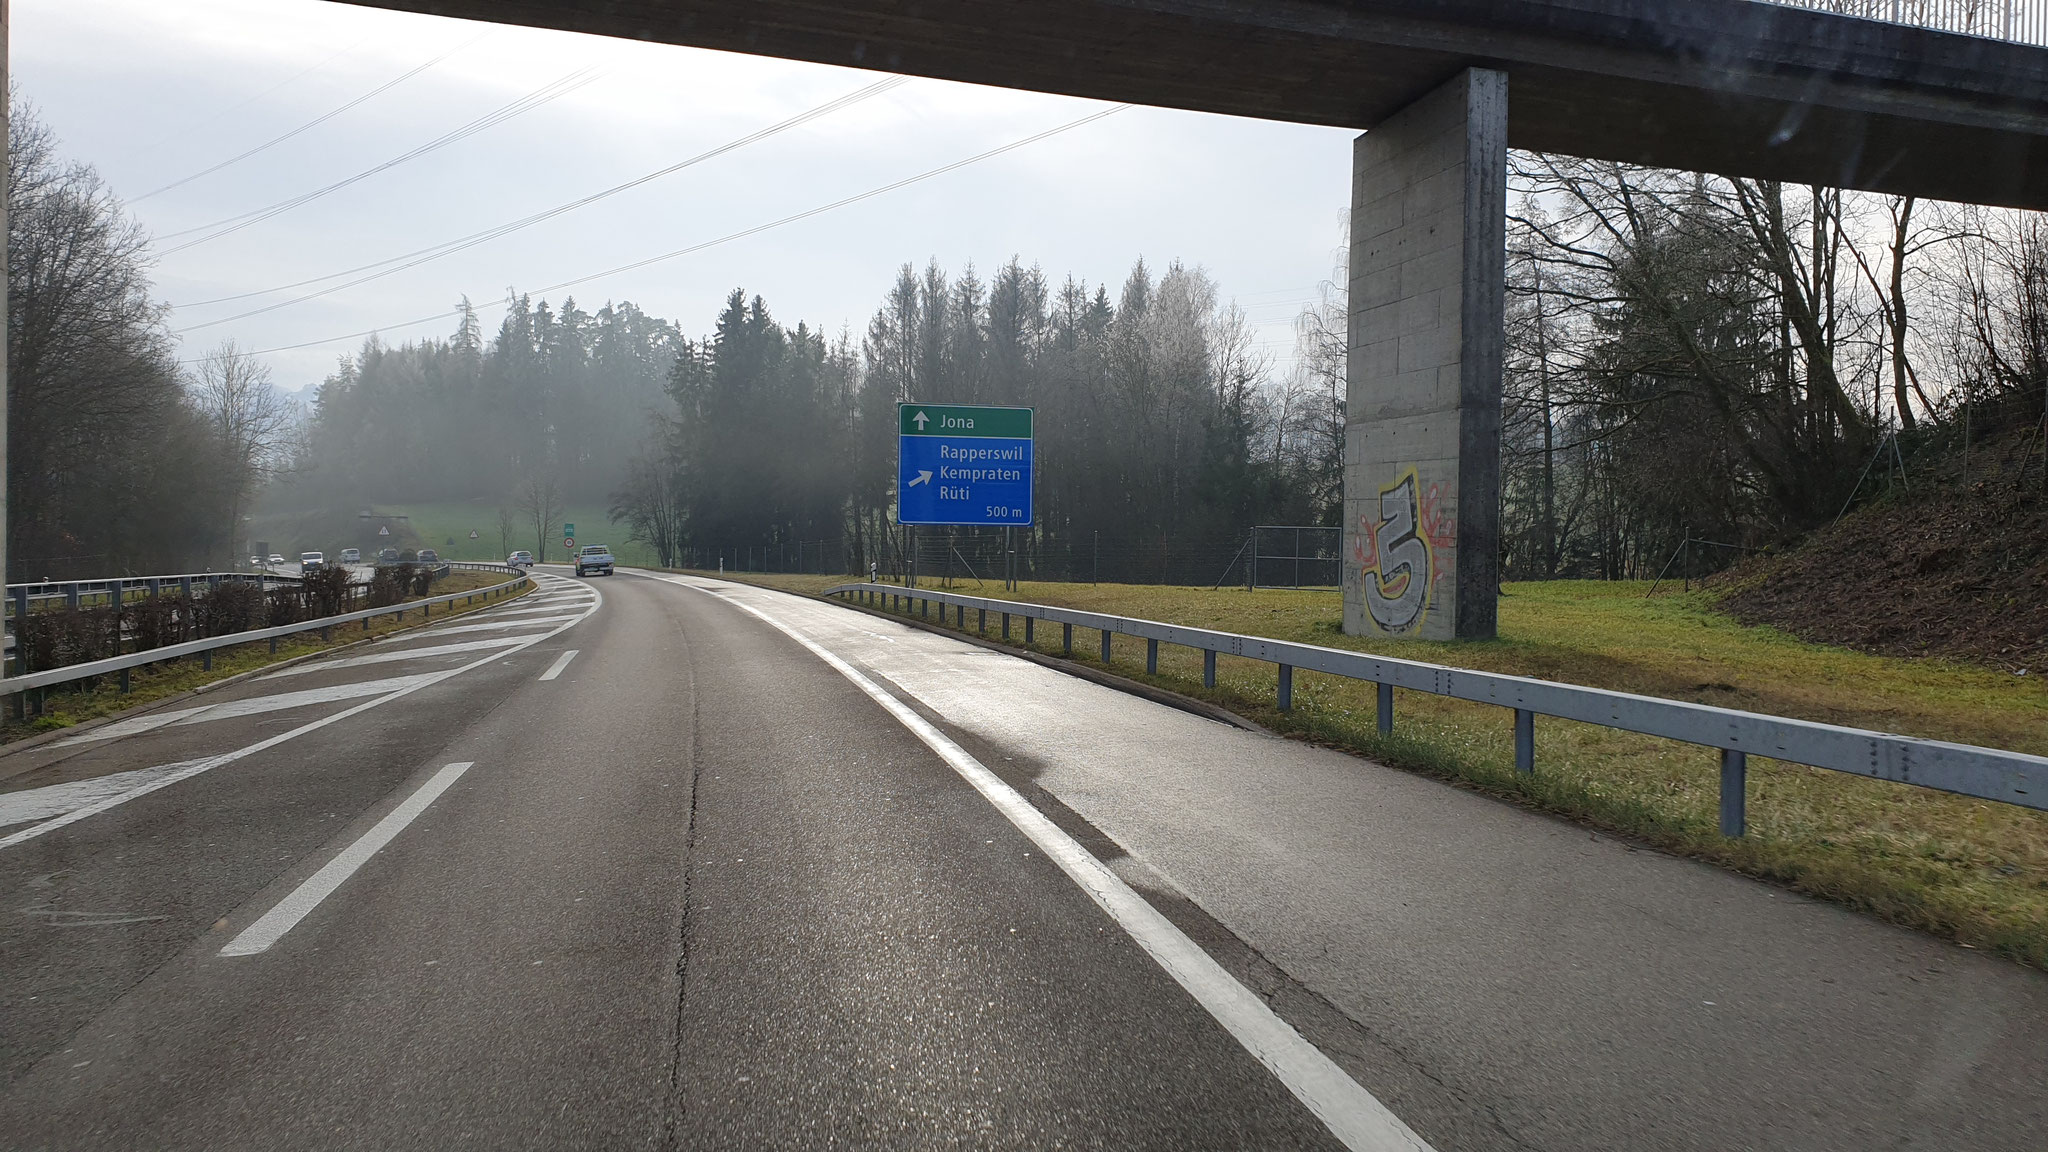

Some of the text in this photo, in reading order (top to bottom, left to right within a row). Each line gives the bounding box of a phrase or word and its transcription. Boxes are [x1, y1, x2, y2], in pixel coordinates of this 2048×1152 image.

[940, 414, 975, 429] Jona
[940, 445, 1023, 462] Rapperswil
[940, 465, 1020, 483] Kempraten
[940, 486, 970, 500] Rüti
[986, 506, 1022, 517] 500 m
